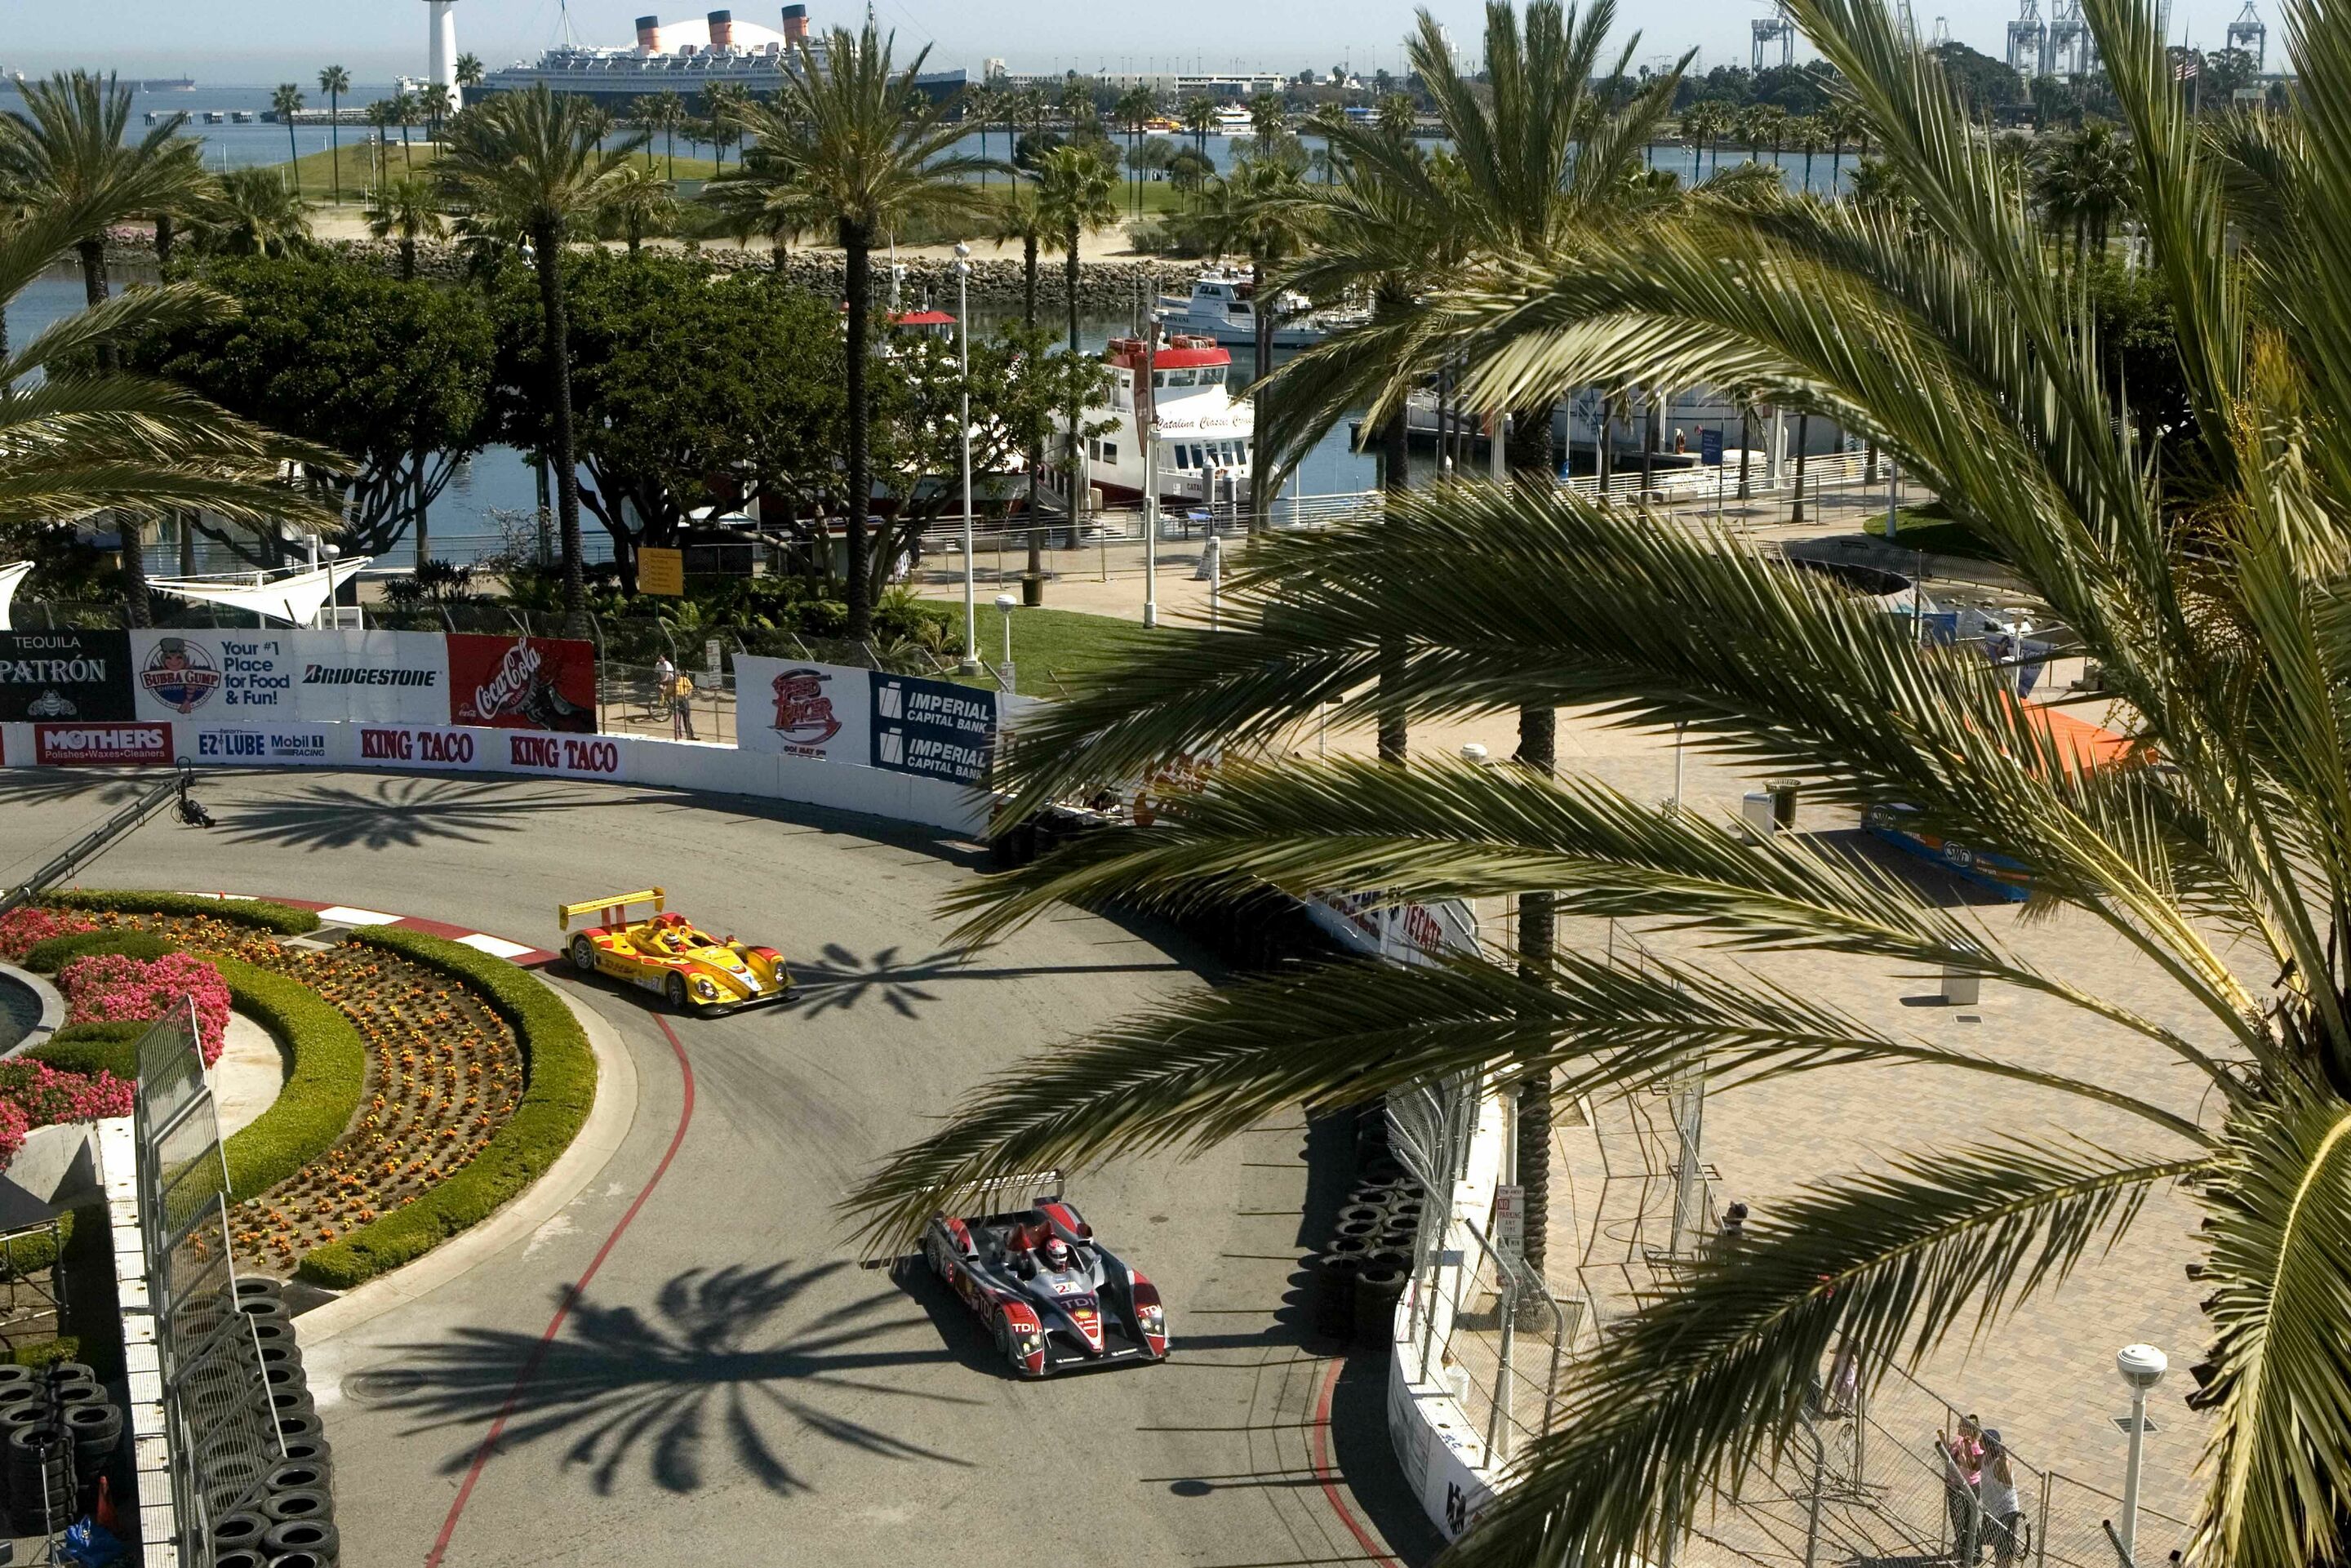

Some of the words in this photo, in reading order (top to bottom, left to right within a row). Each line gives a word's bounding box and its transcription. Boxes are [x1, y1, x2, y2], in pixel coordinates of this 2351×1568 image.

[1156, 418, 1194, 431] Catalina
[12, 636, 82, 649] TEQUILA
[221, 641, 259, 655] Your
[264, 641, 279, 655] #1
[0, 654, 106, 683] PATRÓN
[224, 657, 273, 672] Place
[144, 672, 183, 686] BUBBA
[184, 670, 219, 686] GUMP
[224, 673, 246, 688] for
[250, 673, 290, 688] Food
[302, 664, 437, 686] BRIDGESTONE
[226, 691, 238, 704] &
[244, 691, 278, 704] Fun!
[909, 692, 989, 721] IMPERIAL
[907, 710, 953, 727] CAPITAL
[957, 718, 988, 734] BANK
[43, 729, 165, 749] MOTHERS
[225, 735, 265, 756] LUBE
[271, 735, 309, 748] Mobil
[361, 729, 411, 760] KING
[417, 731, 473, 763] TACO
[293, 748, 325, 757] RACING
[510, 735, 560, 768] KING
[564, 740, 618, 773] TACO
[909, 738, 987, 768] IMPERIAL
[907, 756, 953, 774] CAPITAL
[1403, 899, 1442, 953] TECATE
[744, 976, 753, 984] 7
[1498, 1199, 1509, 1210] NO
[1499, 1211, 1522, 1219] PARKING
[1056, 1285, 1066, 1294] 2
[1060, 1298, 1096, 1308] TDI
[1140, 1305, 1162, 1316] TDI
[1011, 1323, 1035, 1332] TDI
